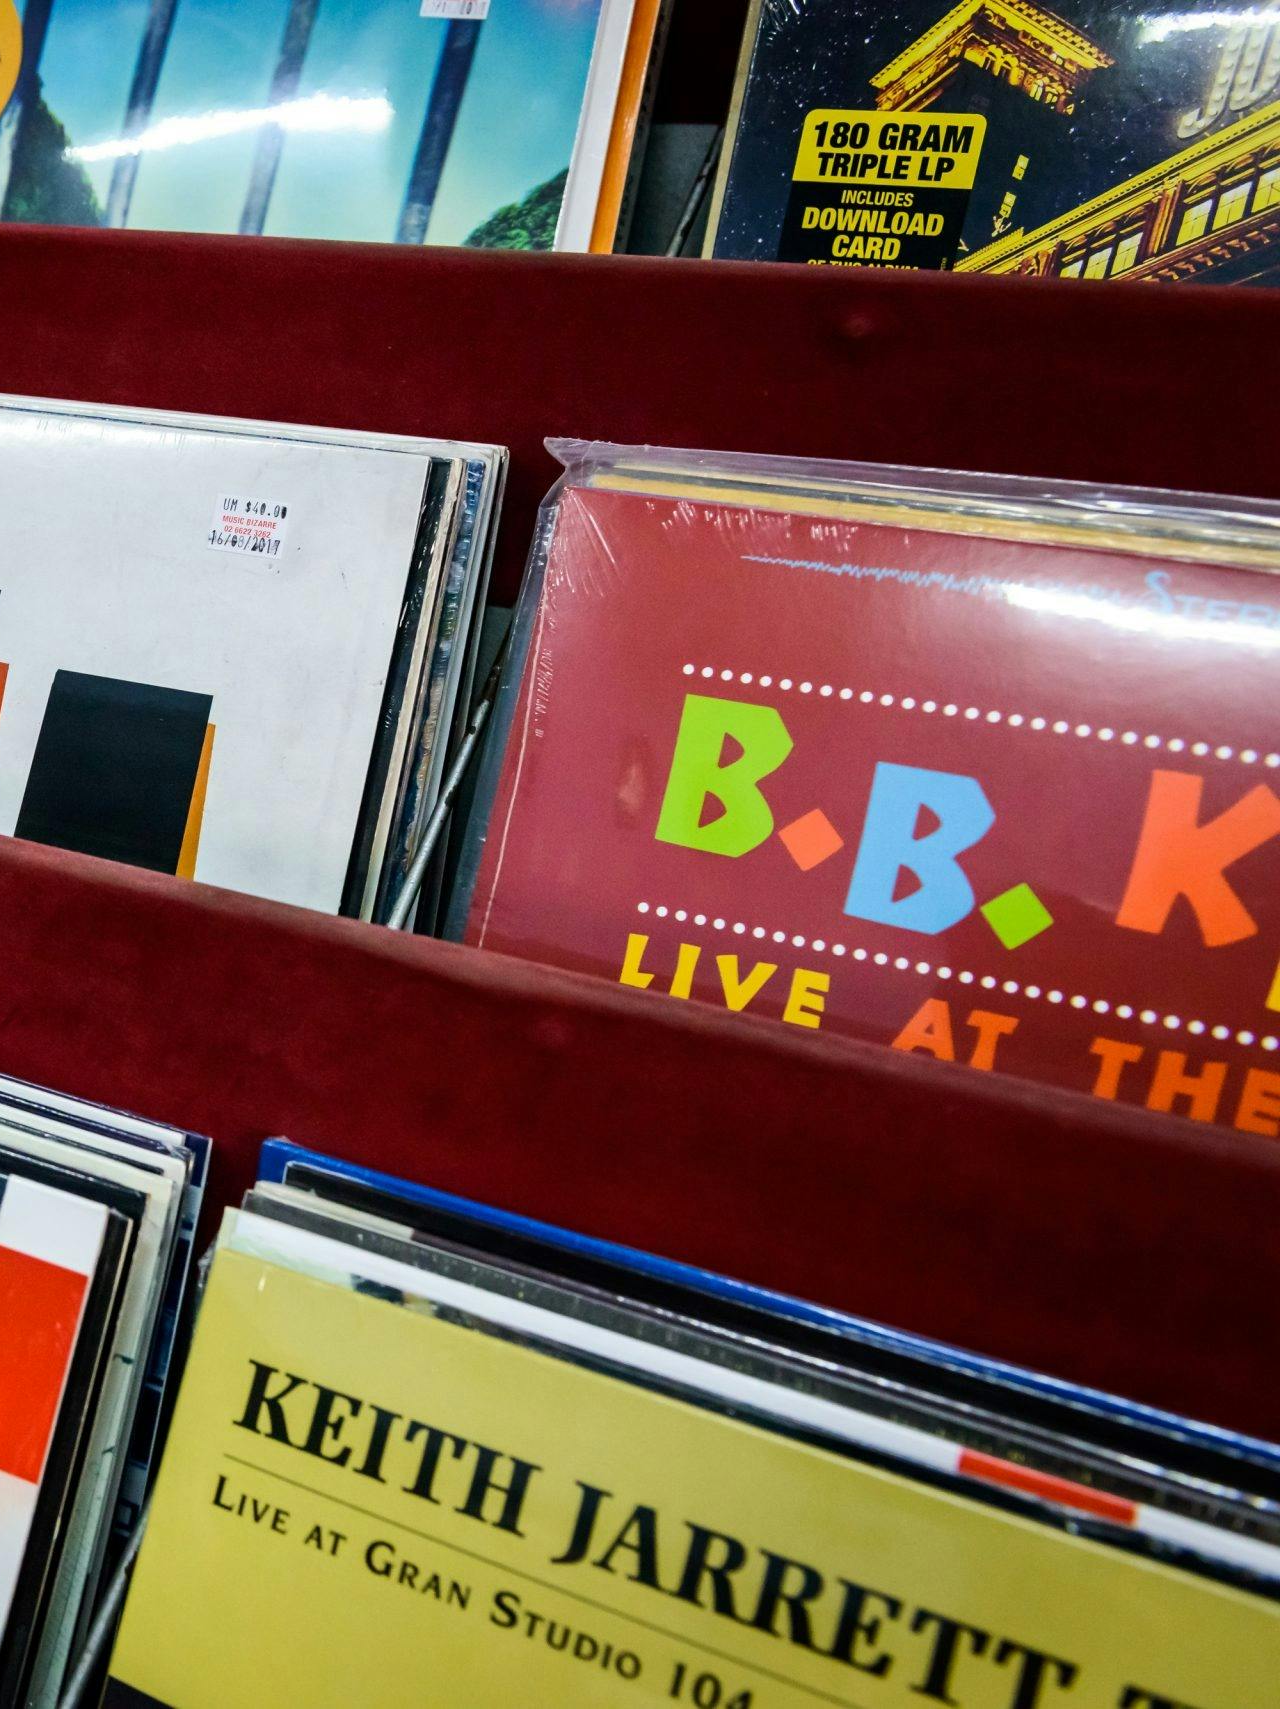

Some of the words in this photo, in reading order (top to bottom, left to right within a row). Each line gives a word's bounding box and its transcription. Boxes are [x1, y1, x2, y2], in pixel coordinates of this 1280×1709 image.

[815, 121, 870, 149] 180
[878, 123, 974, 153] GRAM
[818, 152, 911, 180] TRIPLE
[918, 156, 955, 181] LP
[841, 190, 914, 206] INCLUDES
[802, 206, 944, 236] DOWNLOAD
[832, 235, 901, 260] CARD
[223, 515, 244, 525] MUSIC
[246, 519, 277, 529] BIZARRE
[1115, 769, 1280, 1012] K
[620, 933, 830, 1029] LIVE
[891, 998, 1019, 1072] AT
[1090, 1038, 1280, 1138] THE
[232, 1358, 543, 1538] KEITH
[550, 1479, 1078, 1709] JARRETT
[213, 1474, 290, 1535] LIVE
[305, 1524, 347, 1556] AT
[365, 1540, 471, 1610] GRAN
[489, 1587, 642, 1680] STUDIO
